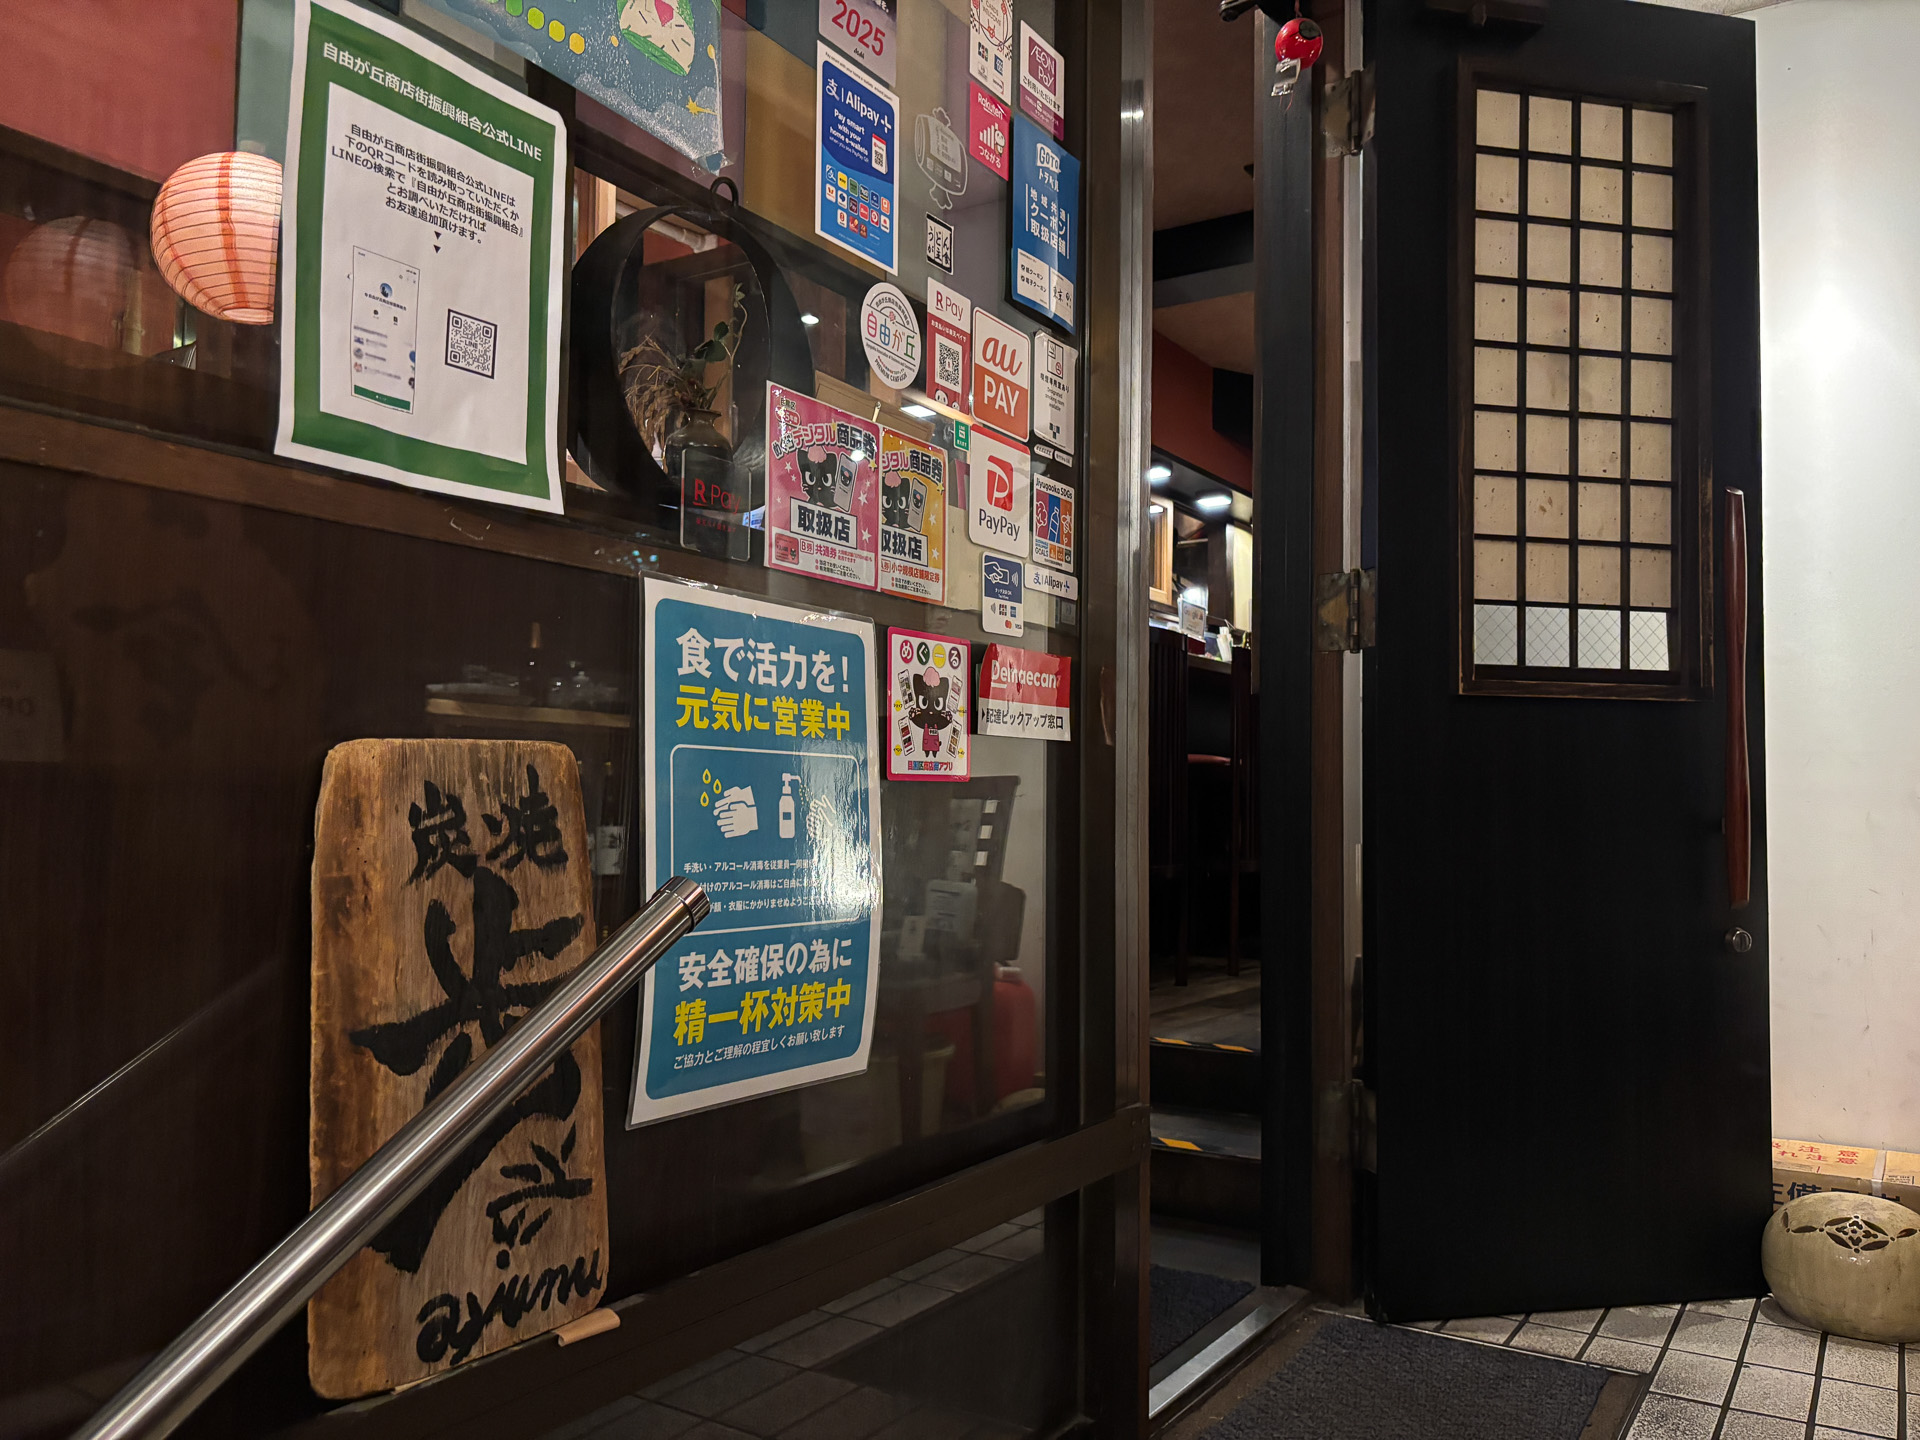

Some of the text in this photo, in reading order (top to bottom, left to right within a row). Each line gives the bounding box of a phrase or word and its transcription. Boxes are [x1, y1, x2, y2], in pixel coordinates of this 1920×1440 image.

[832, 0, 886, 56] 2025
[323, 42, 542, 161] 自由が丘商店街振興組合公式LINE
[834, 108, 865, 135] Pay smart
[977, 92, 1004, 120] Rakuten
[345, 135, 519, 221] 下のQRコードを読み取っていただくか
[352, 124, 516, 207] 自由が丘商店街振興組合公式LINEは
[978, 145, 1001, 169] つながる
[1039, 168, 1059, 193] トラベル
[386, 197, 482, 244] お友達追加頂けます。
[387, 182, 487, 232] とお調べいただければ
[1030, 202, 1067, 236] クーポン
[945, 295, 964, 321] Pay
[867, 310, 916, 361] 自由が丘
[982, 337, 1023, 377] au
[983, 373, 1020, 418] PAY
[711, 484, 741, 515] Pay
[1060, 486, 1073, 500] SDGs
[797, 504, 850, 543] 取扱店
[978, 507, 1020, 542] PayPay
[815, 543, 838, 561] 共通券
[675, 627, 850, 693] 食で活力を！
[675, 684, 850, 741] 元気に営業中
[985, 707, 1064, 730] 配達ピックアップ窓口
[678, 938, 852, 992] 安全確保の為に
[673, 977, 851, 1046] 精一杯対策中
[673, 1024, 845, 1070] ご協力とご理解の程宜しくお願い致します
